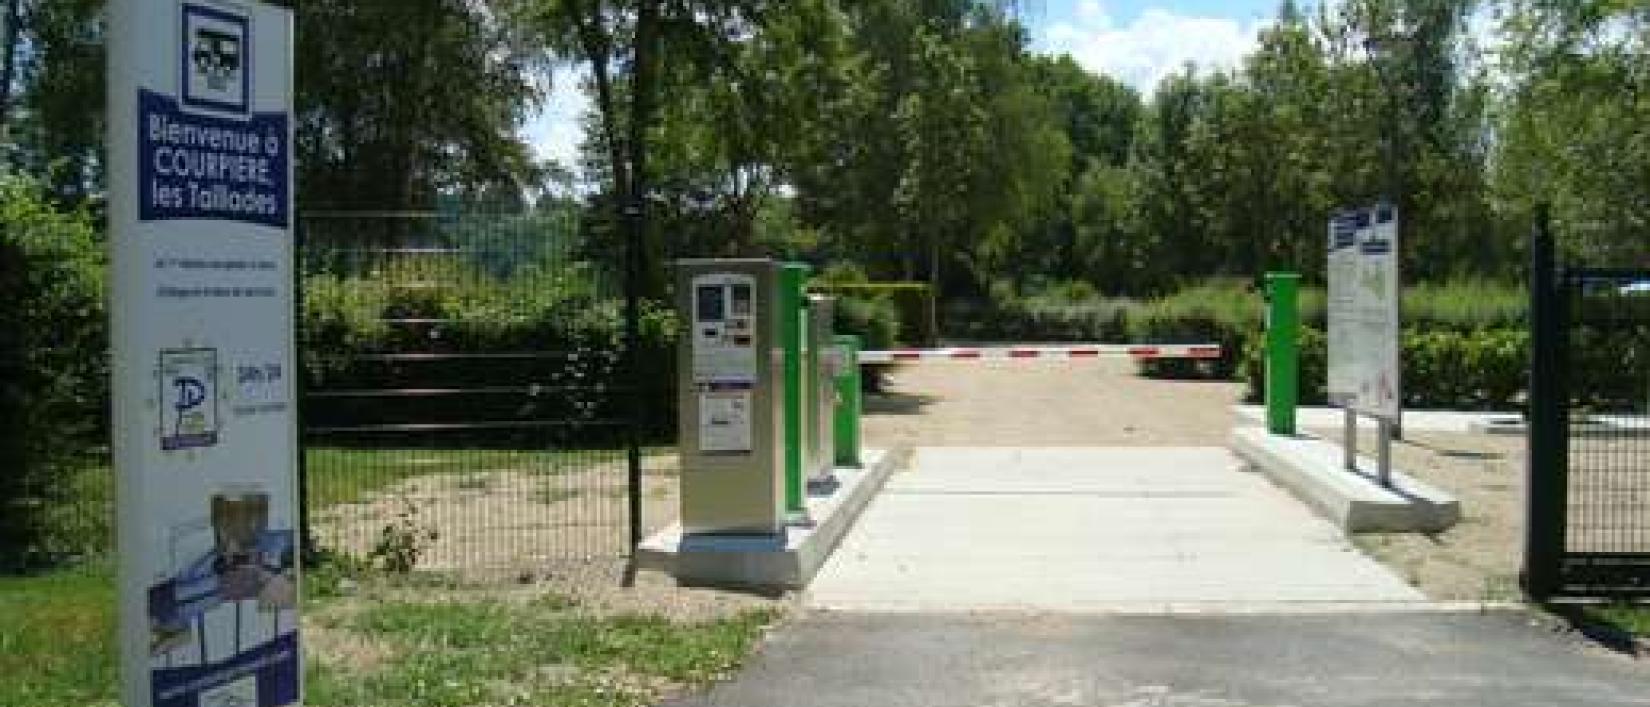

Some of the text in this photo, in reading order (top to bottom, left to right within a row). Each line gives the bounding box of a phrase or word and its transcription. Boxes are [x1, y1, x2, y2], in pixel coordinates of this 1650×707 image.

[149, 113, 259, 154] Bienvenue
[152, 179, 276, 214] les Taillades
